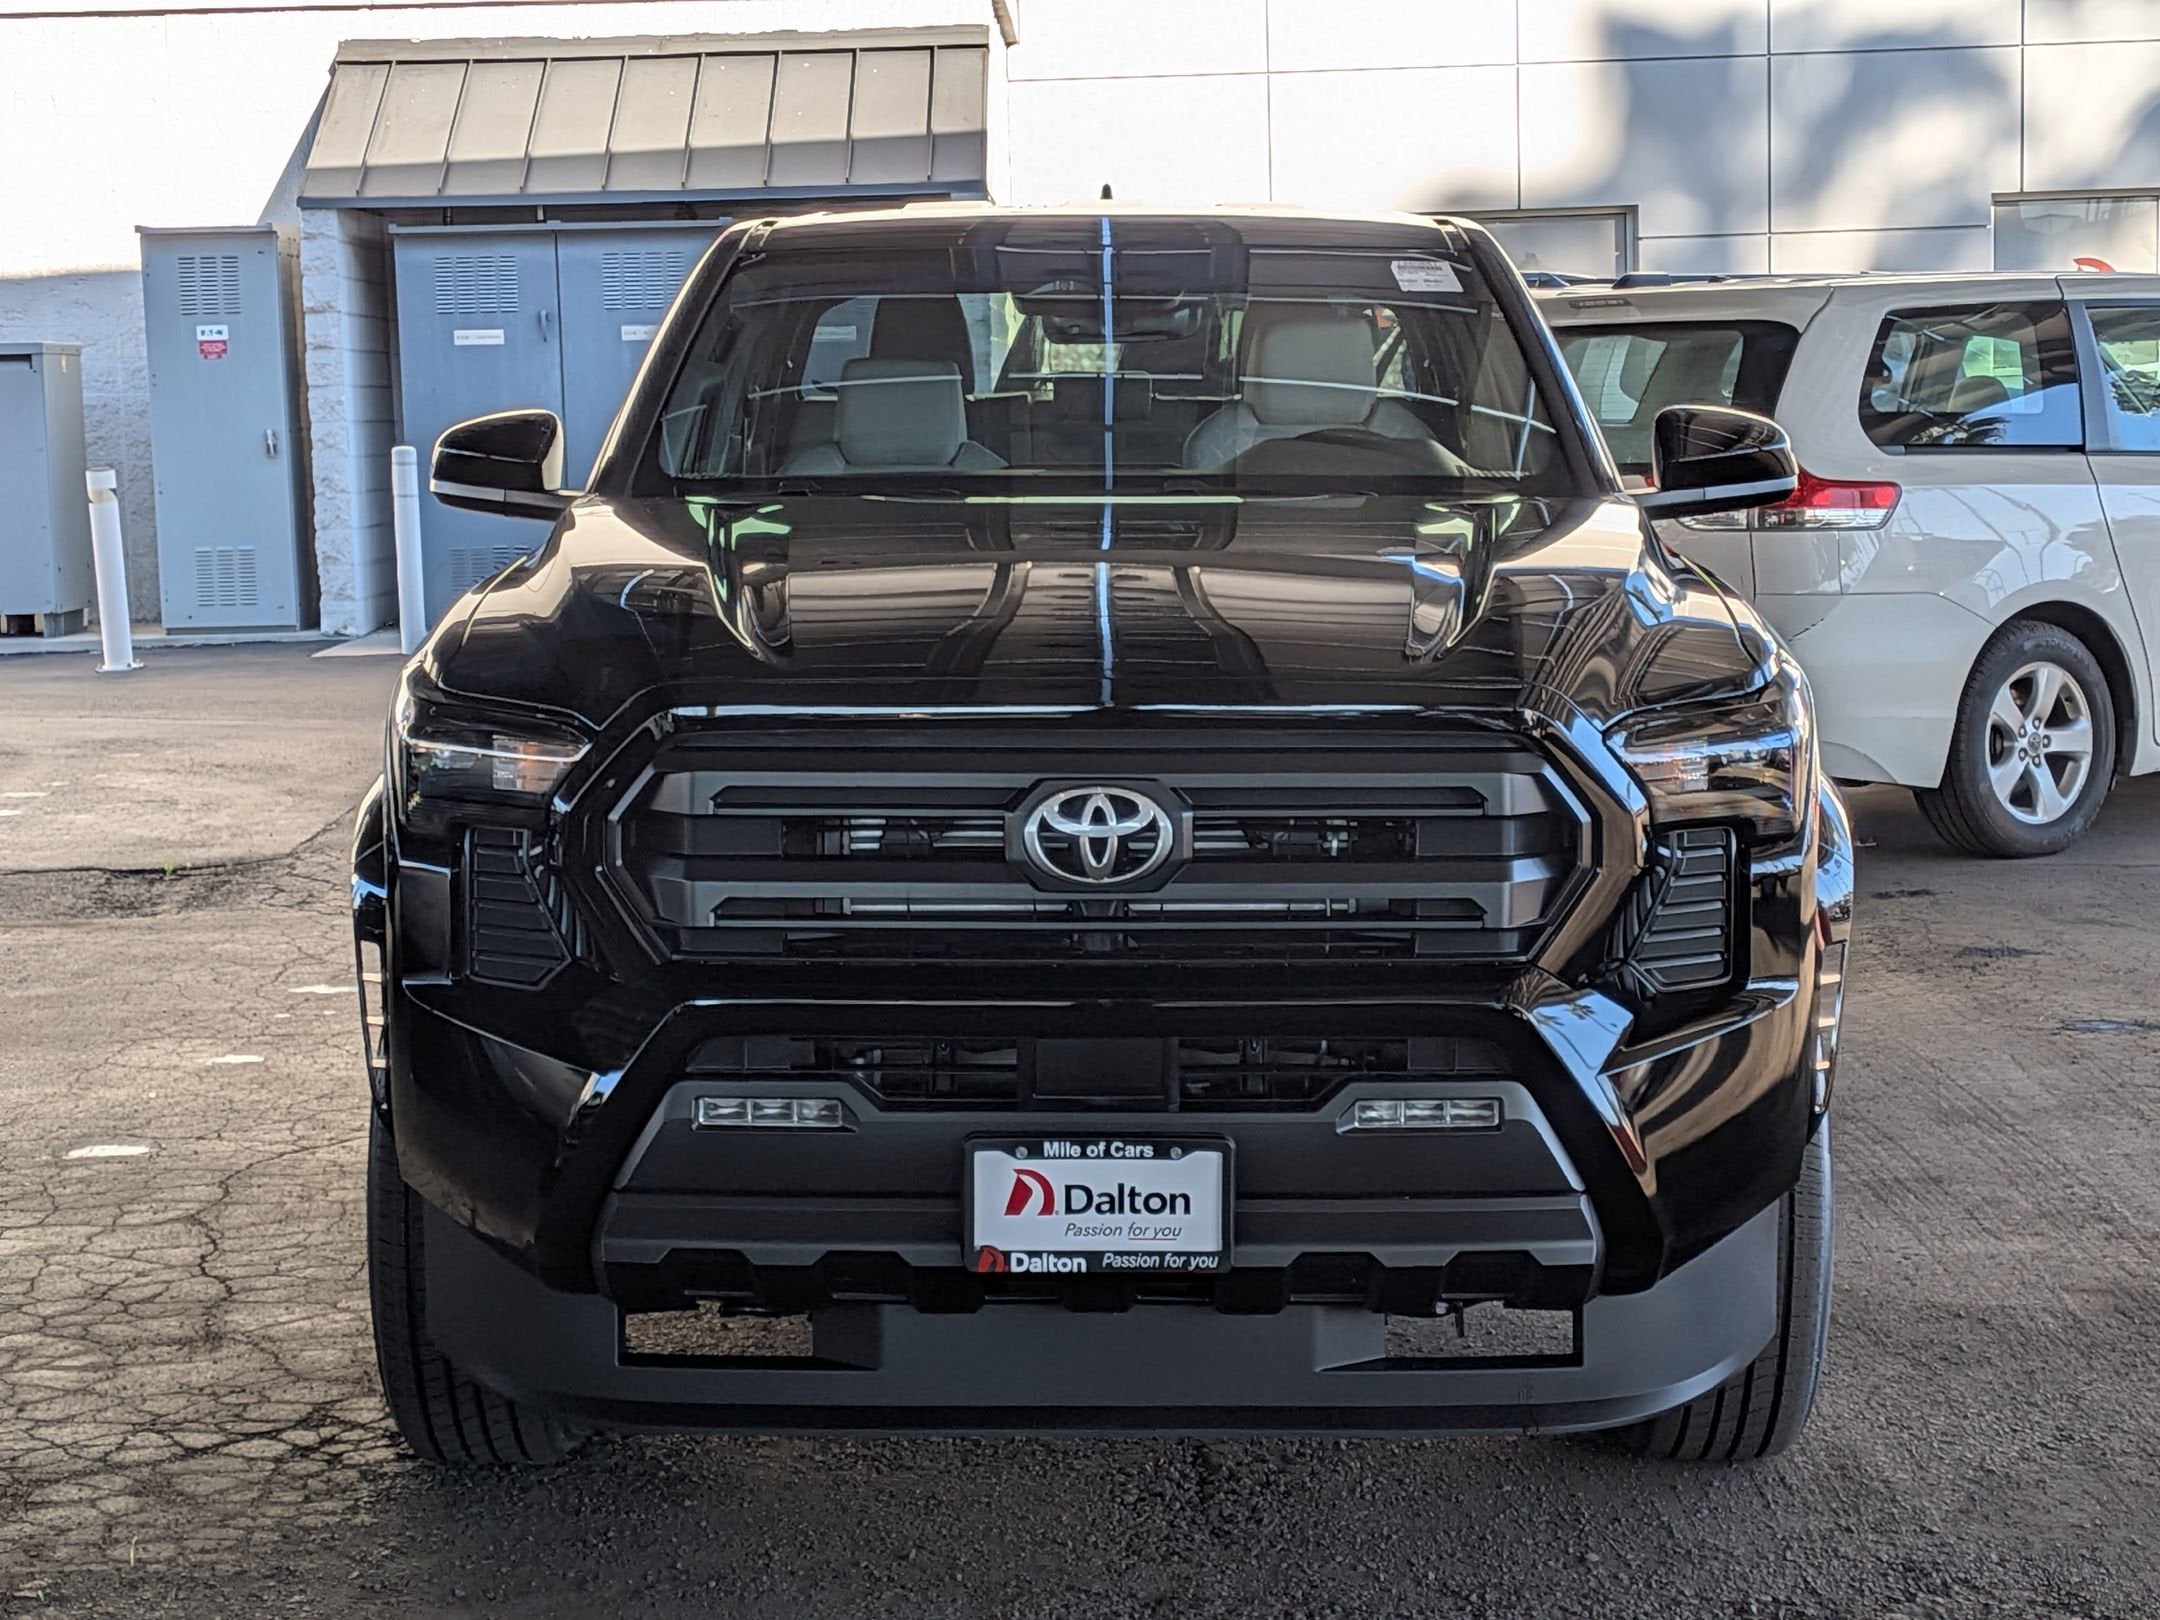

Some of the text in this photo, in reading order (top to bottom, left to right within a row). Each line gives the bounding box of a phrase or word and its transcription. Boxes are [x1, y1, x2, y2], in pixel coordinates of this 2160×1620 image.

[1043, 1141, 1154, 1158] Mile of Cars
[1064, 1183, 1191, 1215] Dalton
[1064, 1223, 1182, 1239] Passion for you
[1010, 1253, 1087, 1273] Dalton
[1102, 1252, 1219, 1271] Passion for you
